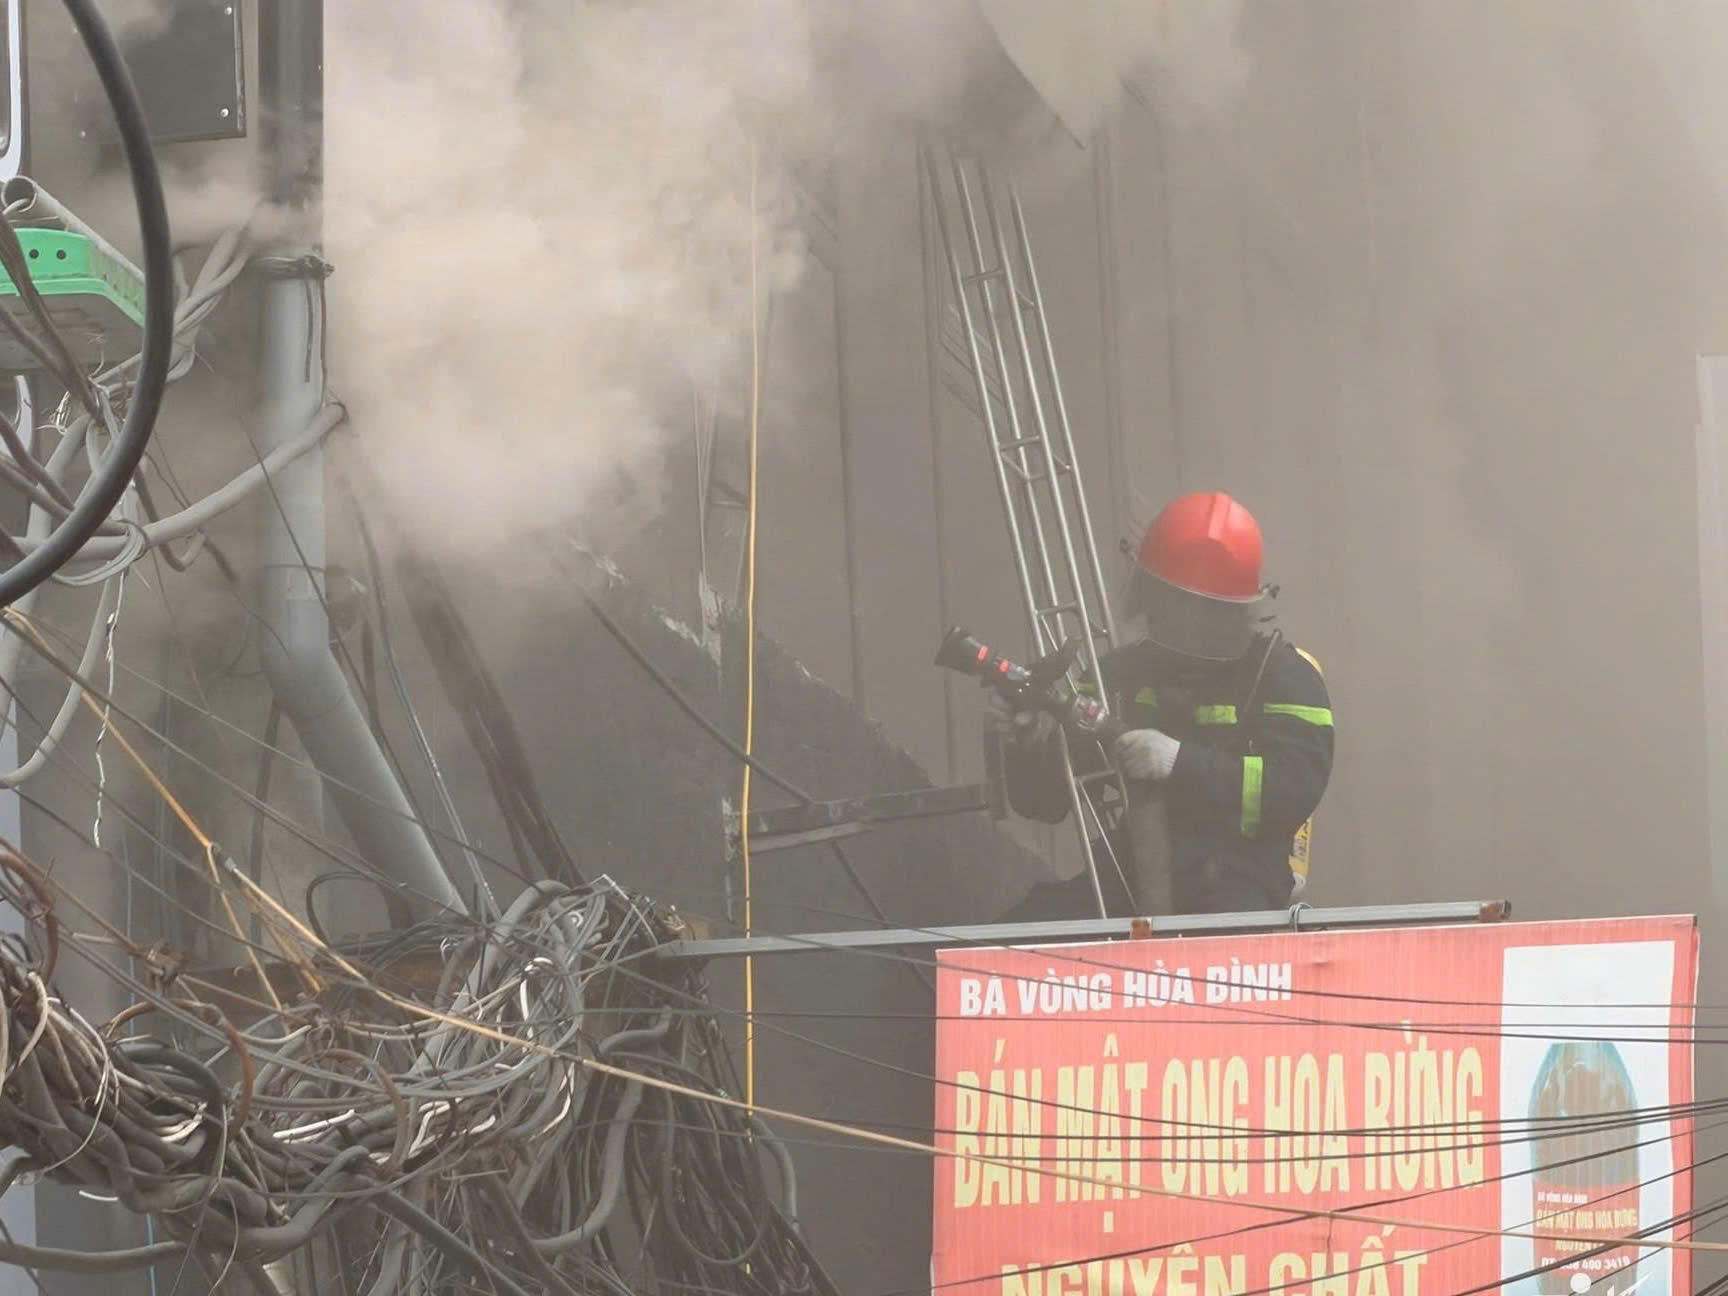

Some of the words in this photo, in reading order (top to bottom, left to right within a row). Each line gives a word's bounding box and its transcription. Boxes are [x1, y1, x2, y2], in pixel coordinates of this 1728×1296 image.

[1016, 967, 1113, 1015] VÒNG
[1122, 959, 1195, 1008] HÒA
[1204, 956, 1293, 1005] BÌNH
[953, 1037, 1042, 1208] BÁN
[1055, 1032, 1149, 1233] MẬT
[1161, 1055, 1249, 1198] ONG
[1263, 1052, 1351, 1195] HOA
[1364, 1019, 1485, 1192] RỪNG
[1001, 1242, 1247, 1296] NGUYÊN
[1268, 1225, 1429, 1296] CHẤT
